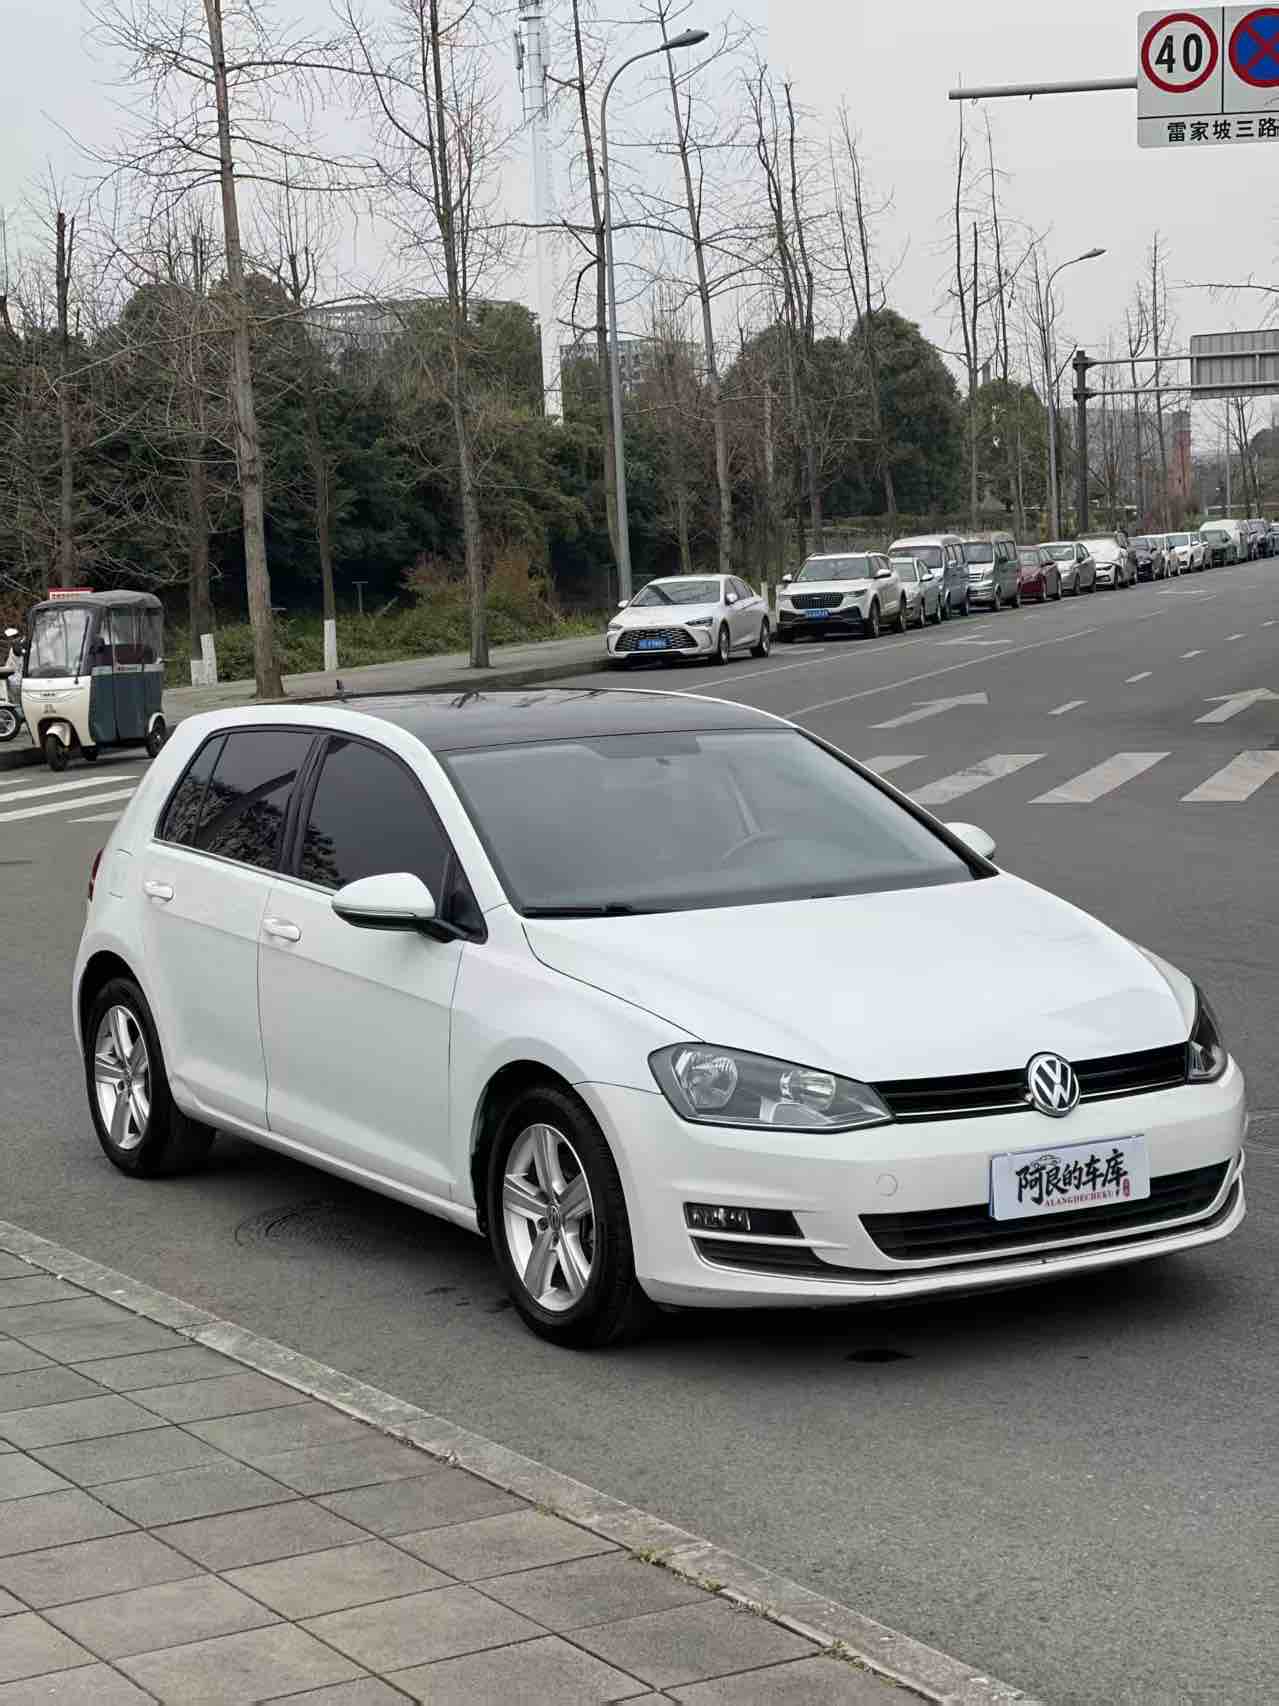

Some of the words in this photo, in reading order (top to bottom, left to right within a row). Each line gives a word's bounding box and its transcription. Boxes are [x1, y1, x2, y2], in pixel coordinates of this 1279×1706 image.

[1154, 33, 1203, 74] 40
[1167, 117, 1279, 142] 雷家坡三路
[1029, 1054, 1076, 1112] VW
